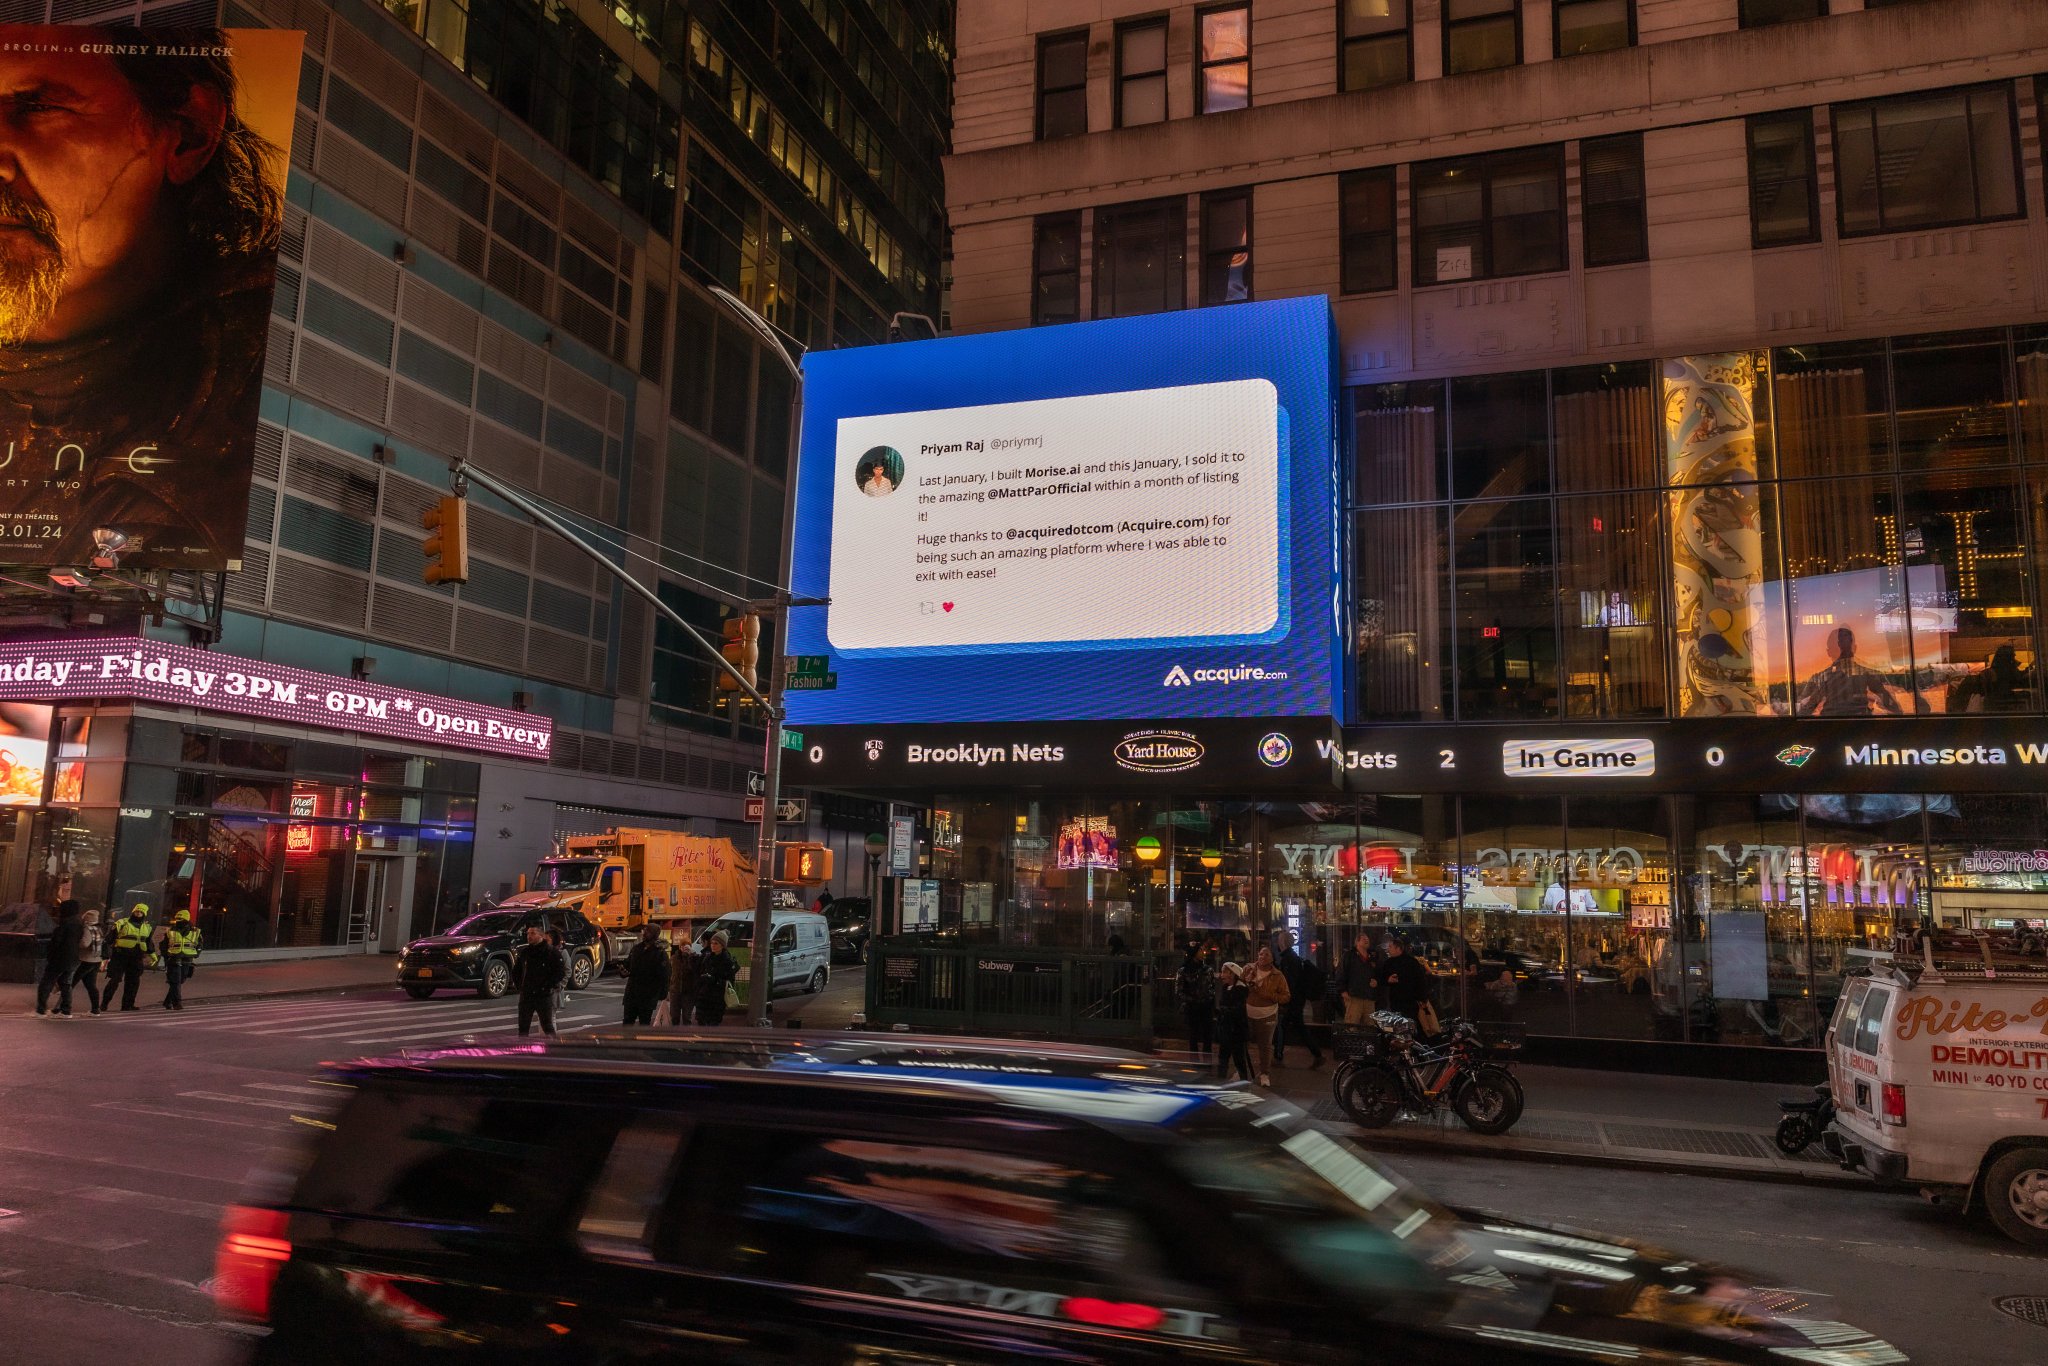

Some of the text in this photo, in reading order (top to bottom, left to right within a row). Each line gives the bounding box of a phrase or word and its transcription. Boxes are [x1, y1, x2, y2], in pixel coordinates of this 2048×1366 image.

[4, 43, 59, 52] BROLIN
[80, 43, 150, 56] GURNEY
[156, 45, 234, 57] HALLECK
[920, 435, 1043, 456] Priyam Raj @priymrj
[919, 452, 1245, 486] Last January, I built Morise.ai and this January, I sold it to
[44, 480, 81, 489] TWO
[918, 471, 1240, 504] the amazing @MattParOfficial within a month of listing
[25, 514, 59, 522] THEATERS
[918, 511, 928, 522] it!
[917, 514, 1231, 546] Huge thanks to @acquiredotcom (Acquire.com) for
[916, 536, 1227, 565] being such an amazing platform where I was able to
[915, 567, 996, 582] exit with ease!
[804, 657, 811, 671] 7
[1193, 663, 1288, 684] acquire.com
[789, 674, 834, 688] Fashion Av
[224, 673, 301, 705] 3PM
[326, 691, 389, 719] 6PM
[417, 707, 481, 735] Open
[485, 719, 550, 750] Every
[809, 745, 823, 763] 0
[864, 740, 884, 750] NETS
[1125, 744, 1197, 758] Yard House
[1845, 743, 2048, 765] Minnesota W
[908, 743, 1064, 767] Brooklyn Nets
[1345, 750, 1398, 769] Jets
[1440, 749, 1455, 768] 2
[1520, 748, 1636, 768] In Game
[1706, 747, 1724, 766] 0
[293, 797, 313, 806] Meet
[294, 807, 311, 815] Me
[978, 960, 1014, 973] Subway
[1931, 1045, 2048, 1070] DEMOLIT
[1932, 1069, 1969, 1084] MINI
[1985, 1073, 2005, 1087] 40
[2007, 1075, 2027, 1089] YD
